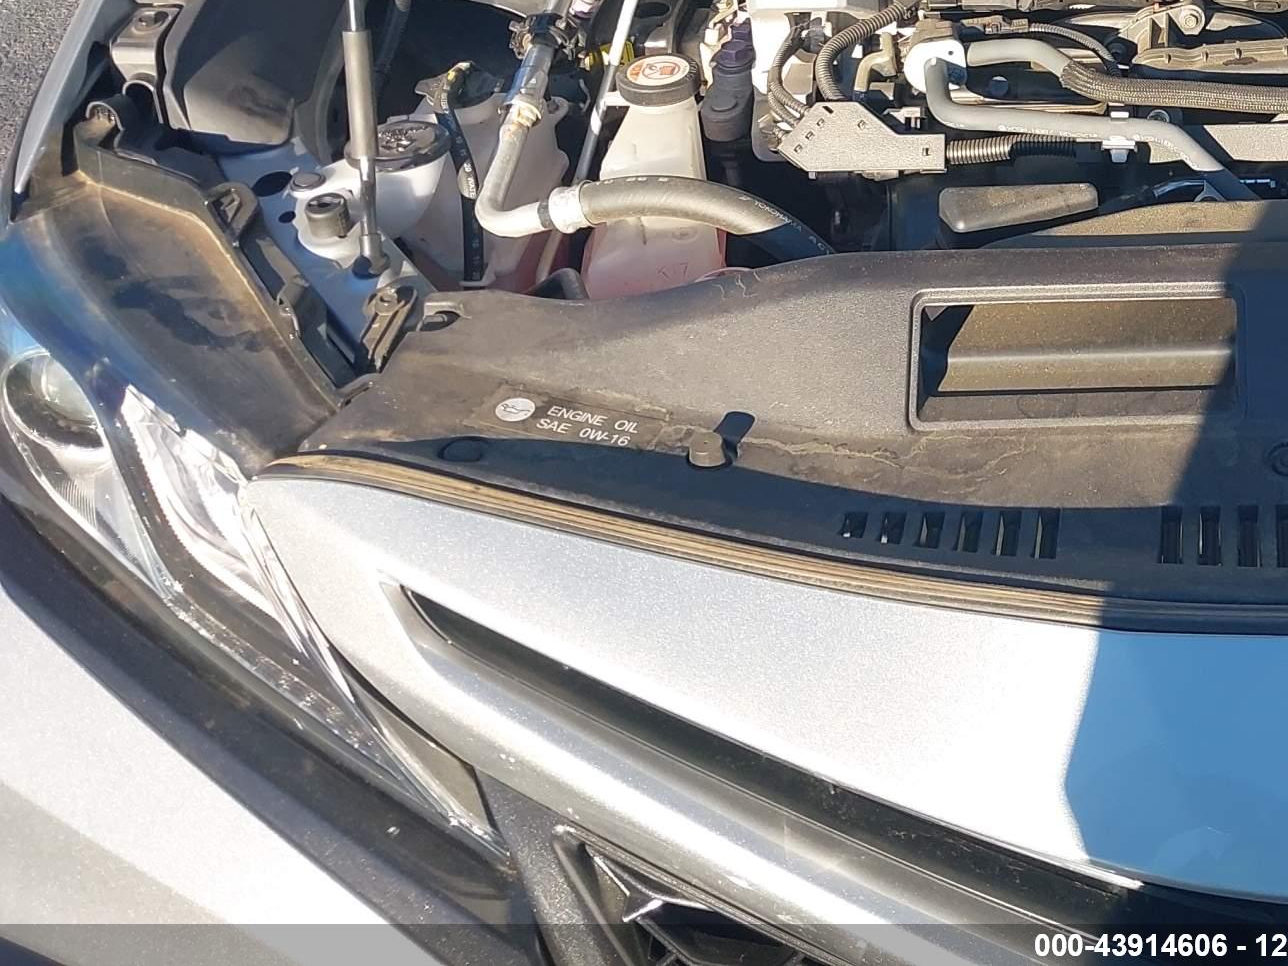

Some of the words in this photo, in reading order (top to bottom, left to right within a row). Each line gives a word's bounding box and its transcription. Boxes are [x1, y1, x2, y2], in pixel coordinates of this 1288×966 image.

[535, 417, 573, 435] SAE
[578, 426, 632, 447] 0W-16
[547, 405, 609, 427] ENGINE
[613, 419, 639, 434] OIL
